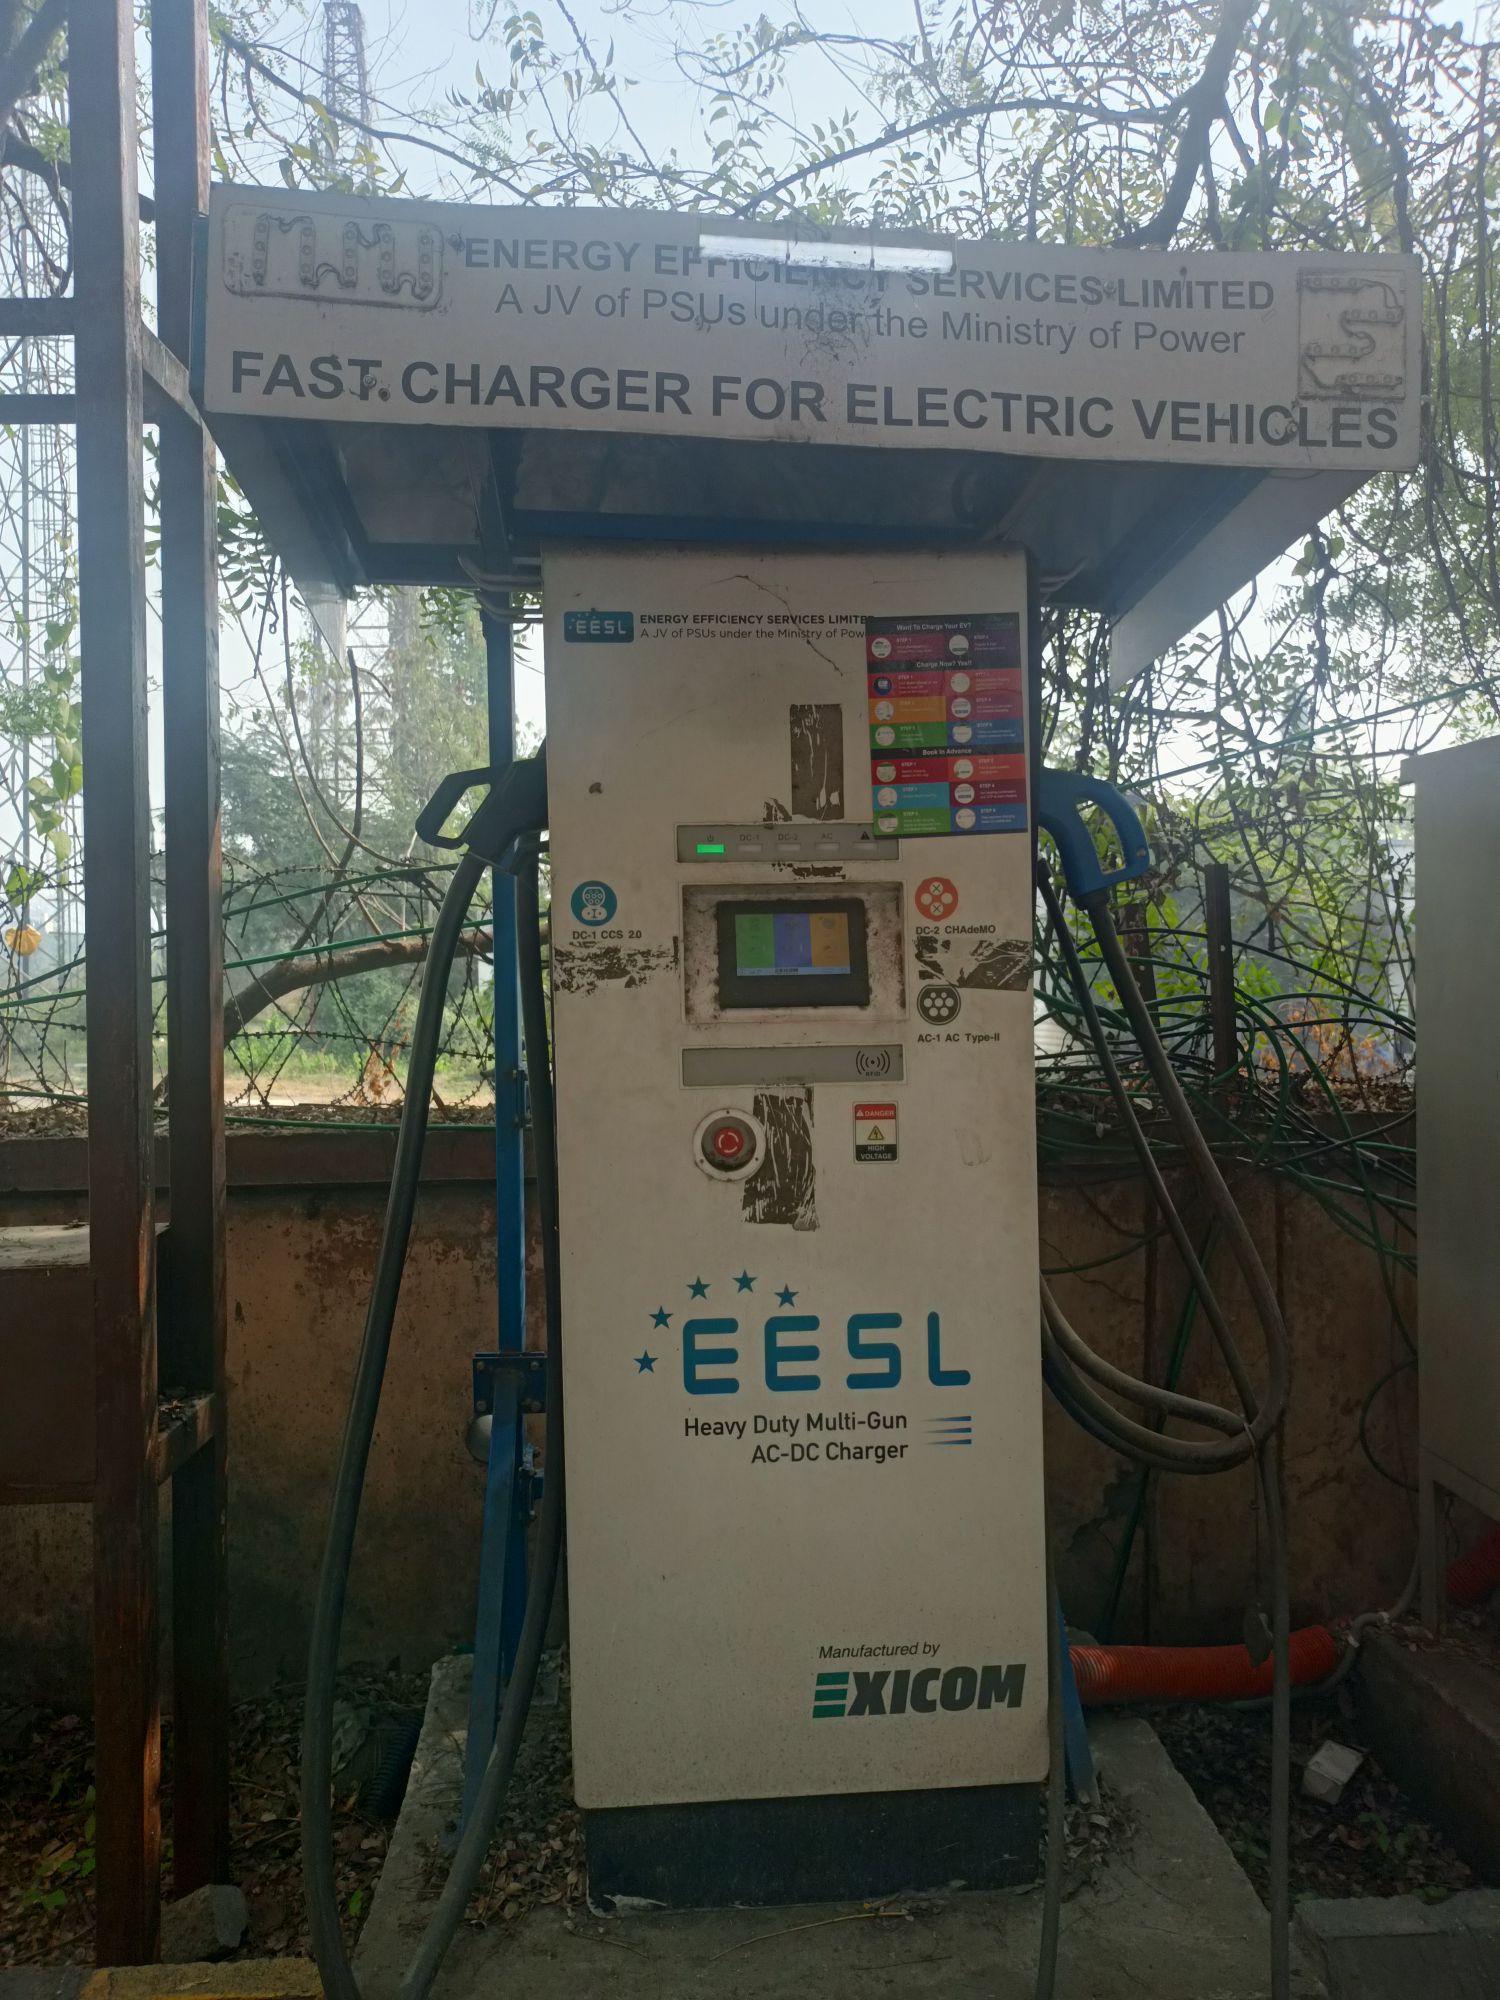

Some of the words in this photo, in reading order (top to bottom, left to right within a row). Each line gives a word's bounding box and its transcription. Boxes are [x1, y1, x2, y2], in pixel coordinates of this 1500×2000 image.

[464, 237, 639, 273] ENERGY
[653, 243, 888, 293] EFFICIENCY
[905, 263, 1103, 307] SERVICES
[1117, 278, 1275, 311] LIMITED
[495, 283, 523, 314] A
[533, 284, 582, 316] JV
[594, 287, 632, 318] of
[642, 288, 746, 326] PSUs
[760, 301, 867, 334] under
[873, 308, 928, 338] the
[941, 311, 1077, 355] Ministry
[1088, 320, 1122, 350] of
[1134, 321, 1246, 354] Power
[231, 350, 383, 401] FAST
[401, 360, 693, 416] CHARGER
[713, 374, 828, 424] FOR
[846, 382, 1115, 440] ELECTRIC
[1131, 399, 1399, 451] VEHICLES
[576, 619, 628, 635] EESL
[639, 614, 689, 625] ENERGY
[692, 614, 763, 625] EFFICIENCY
[766, 614, 826, 625] SERVICES
[828, 614, 874, 625] LIMITE
[922, 623, 944, 631] Charge
[640, 628, 650, 639] A
[653, 628, 667, 639] JV
[671, 627, 684, 639] of
[686, 628, 717, 639] PSUs
[719, 627, 752, 639] under
[754, 627, 775, 639] the
[777, 627, 822, 641] Ministry
[825, 627, 838, 639] of
[840, 628, 866, 639] Pow
[739, 833, 760, 842] DC-1
[777, 833, 799, 842] DC-2
[820, 833, 833, 841] AC
[572, 930, 598, 940] DC-1
[600, 930, 624, 940] CCS
[628, 929, 643, 940] 2.0
[915, 926, 940, 935] DC-2
[944, 925, 997, 935] CHAdeMO
[917, 1034, 940, 1043] AC-1
[945, 1033, 960, 1042] AC
[964, 1032, 1001, 1044] Type-II
[682, 1310, 972, 1395] EESL
[684, 1416, 747, 1440] Heavy
[752, 1413, 800, 1436] Duty
[805, 1411, 908, 1433] Multi-Gun
[751, 1443, 820, 1464] AC-DC
[825, 1440, 910, 1464] Charger
[818, 1642, 919, 1660] Manufactured
[922, 1641, 941, 1657] by
[811, 1663, 1027, 1719] EXICOM
